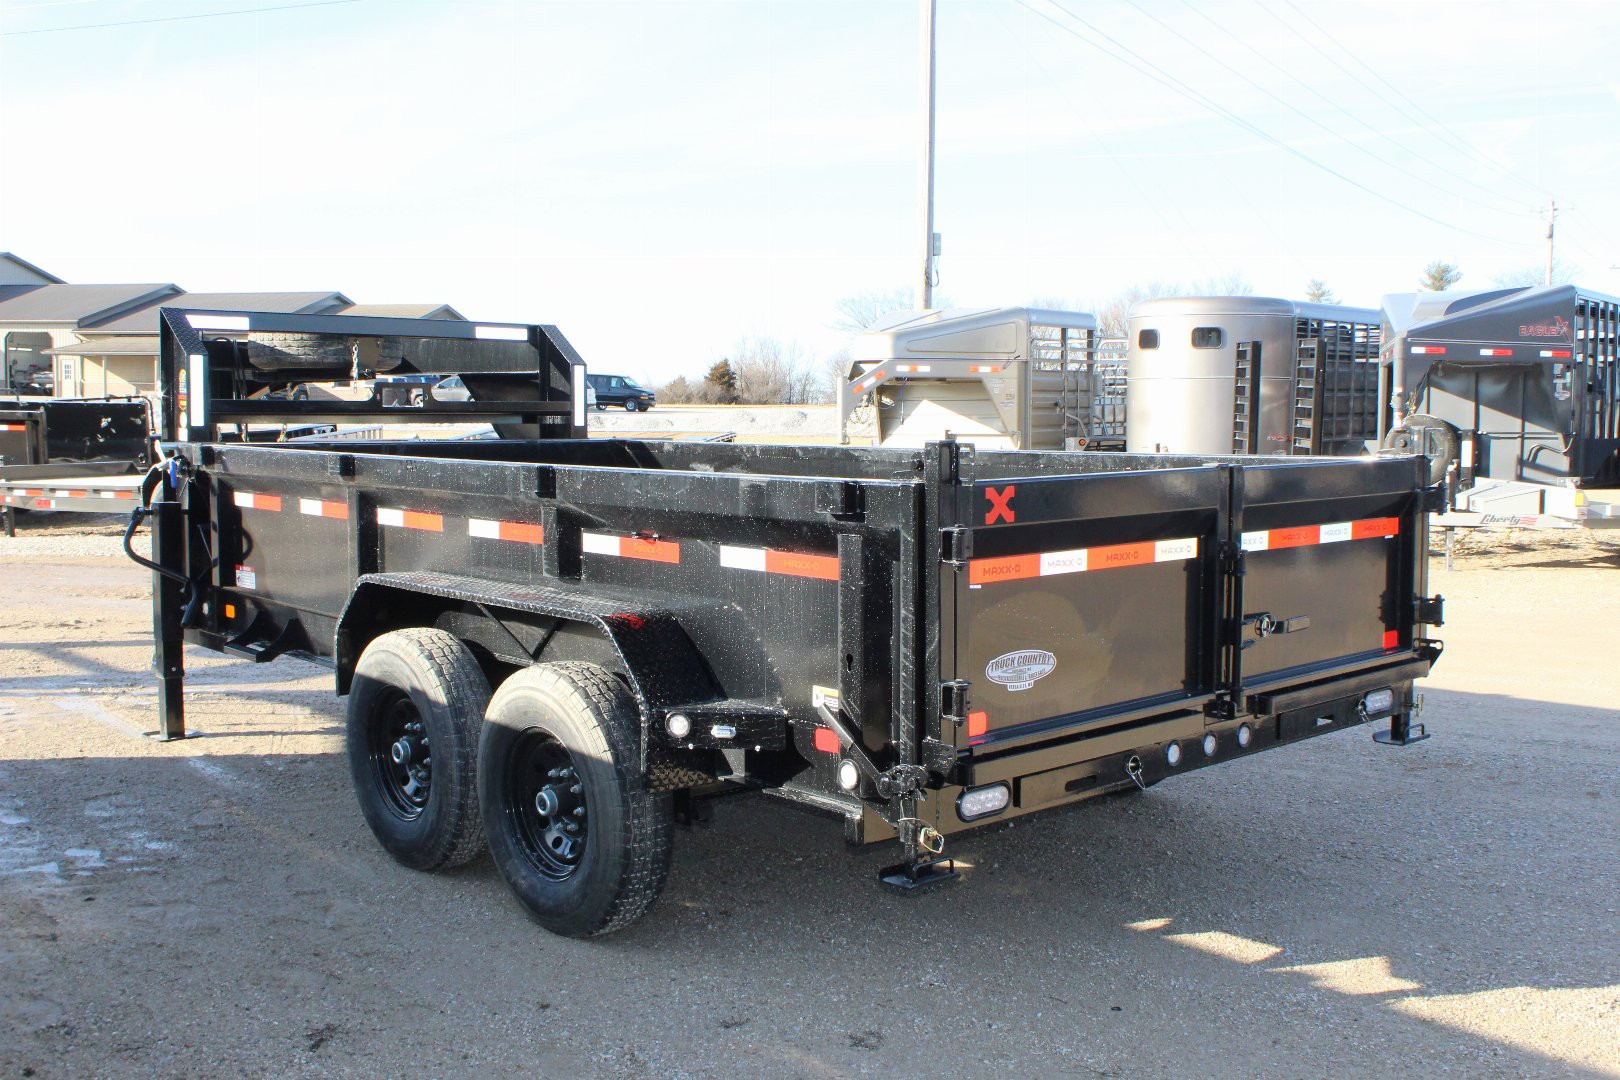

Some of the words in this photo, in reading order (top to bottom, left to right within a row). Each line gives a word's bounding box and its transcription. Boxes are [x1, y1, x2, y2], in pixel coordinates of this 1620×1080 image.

[1519, 325, 1557, 336] EAGLE
[985, 485, 1015, 525] X
[1480, 514, 1521, 525] Liberty
[991, 656, 1016, 672] TRUCK
[1017, 652, 1053, 667] COUNTRY
